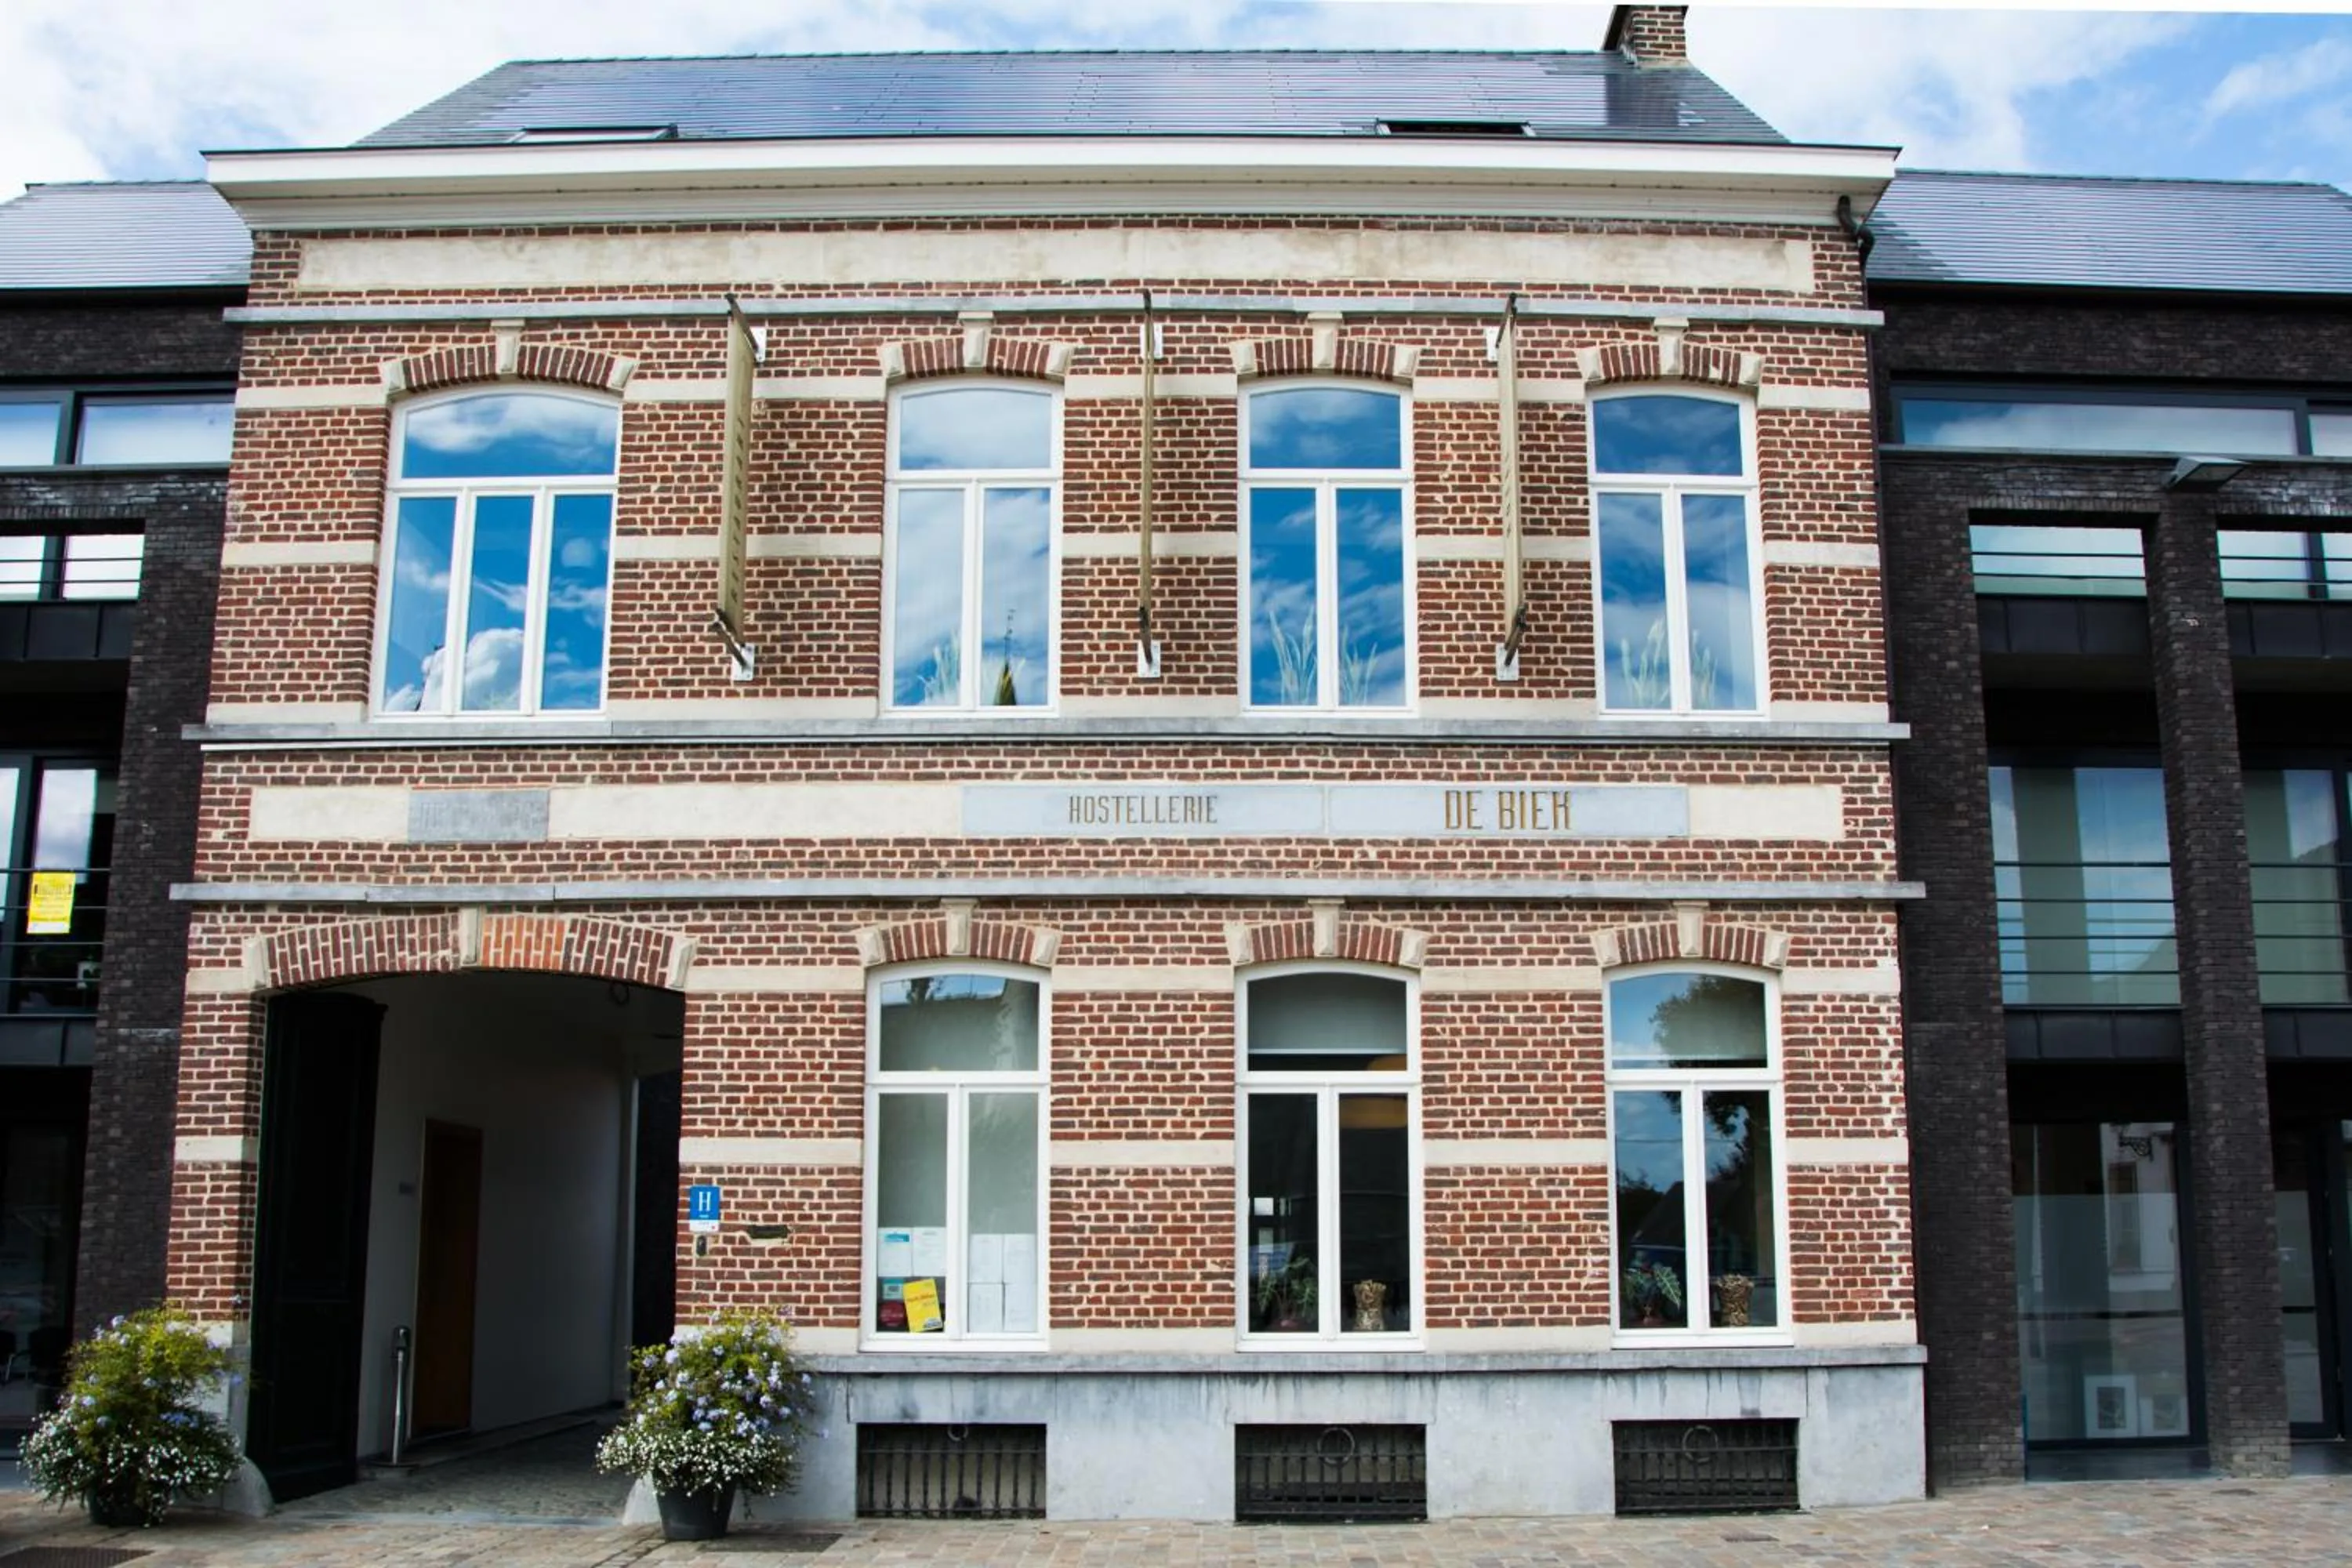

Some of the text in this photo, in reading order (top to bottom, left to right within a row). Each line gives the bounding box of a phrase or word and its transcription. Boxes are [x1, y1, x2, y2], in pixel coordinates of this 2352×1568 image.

[1069, 795, 1218, 824] HOSTELLERIE
[1445, 789, 1483, 829] DE
[699, 1191, 712, 1212] H
